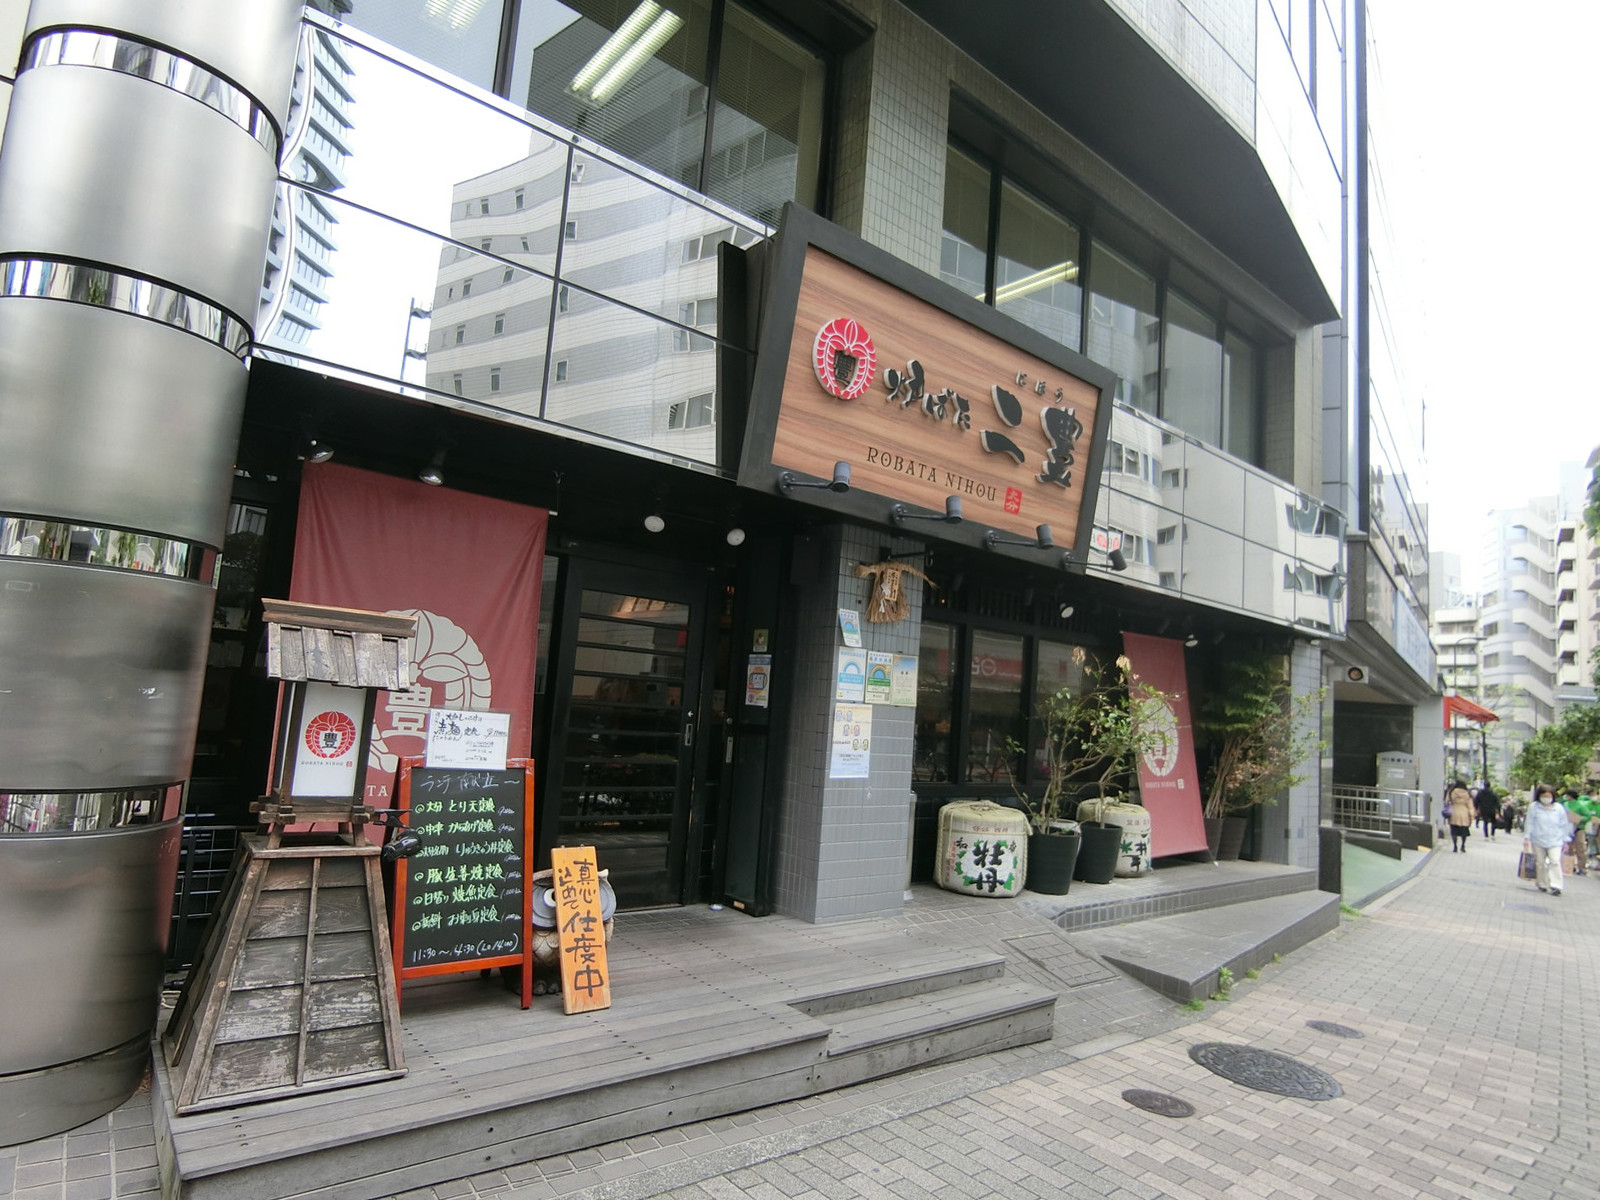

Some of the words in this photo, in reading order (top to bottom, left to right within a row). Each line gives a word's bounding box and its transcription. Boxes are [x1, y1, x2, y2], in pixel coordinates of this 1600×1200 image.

[1016, 370, 1064, 403] にほう
[866, 446, 938, 483] ROBATA
[945, 472, 997, 502] NIHOU
[420, 774, 452, 794] ランチ
[426, 801, 443, 813] 大分
[449, 797, 495, 813] とり天定食
[424, 890, 450, 906] 日替り
[452, 883, 499, 904] 焼魚定食
[558, 866, 579, 910] 込めて
[573, 858, 597, 904] 真心
[447, 904, 500, 927] お刺身定食
[562, 909, 605, 998] 仕度中
